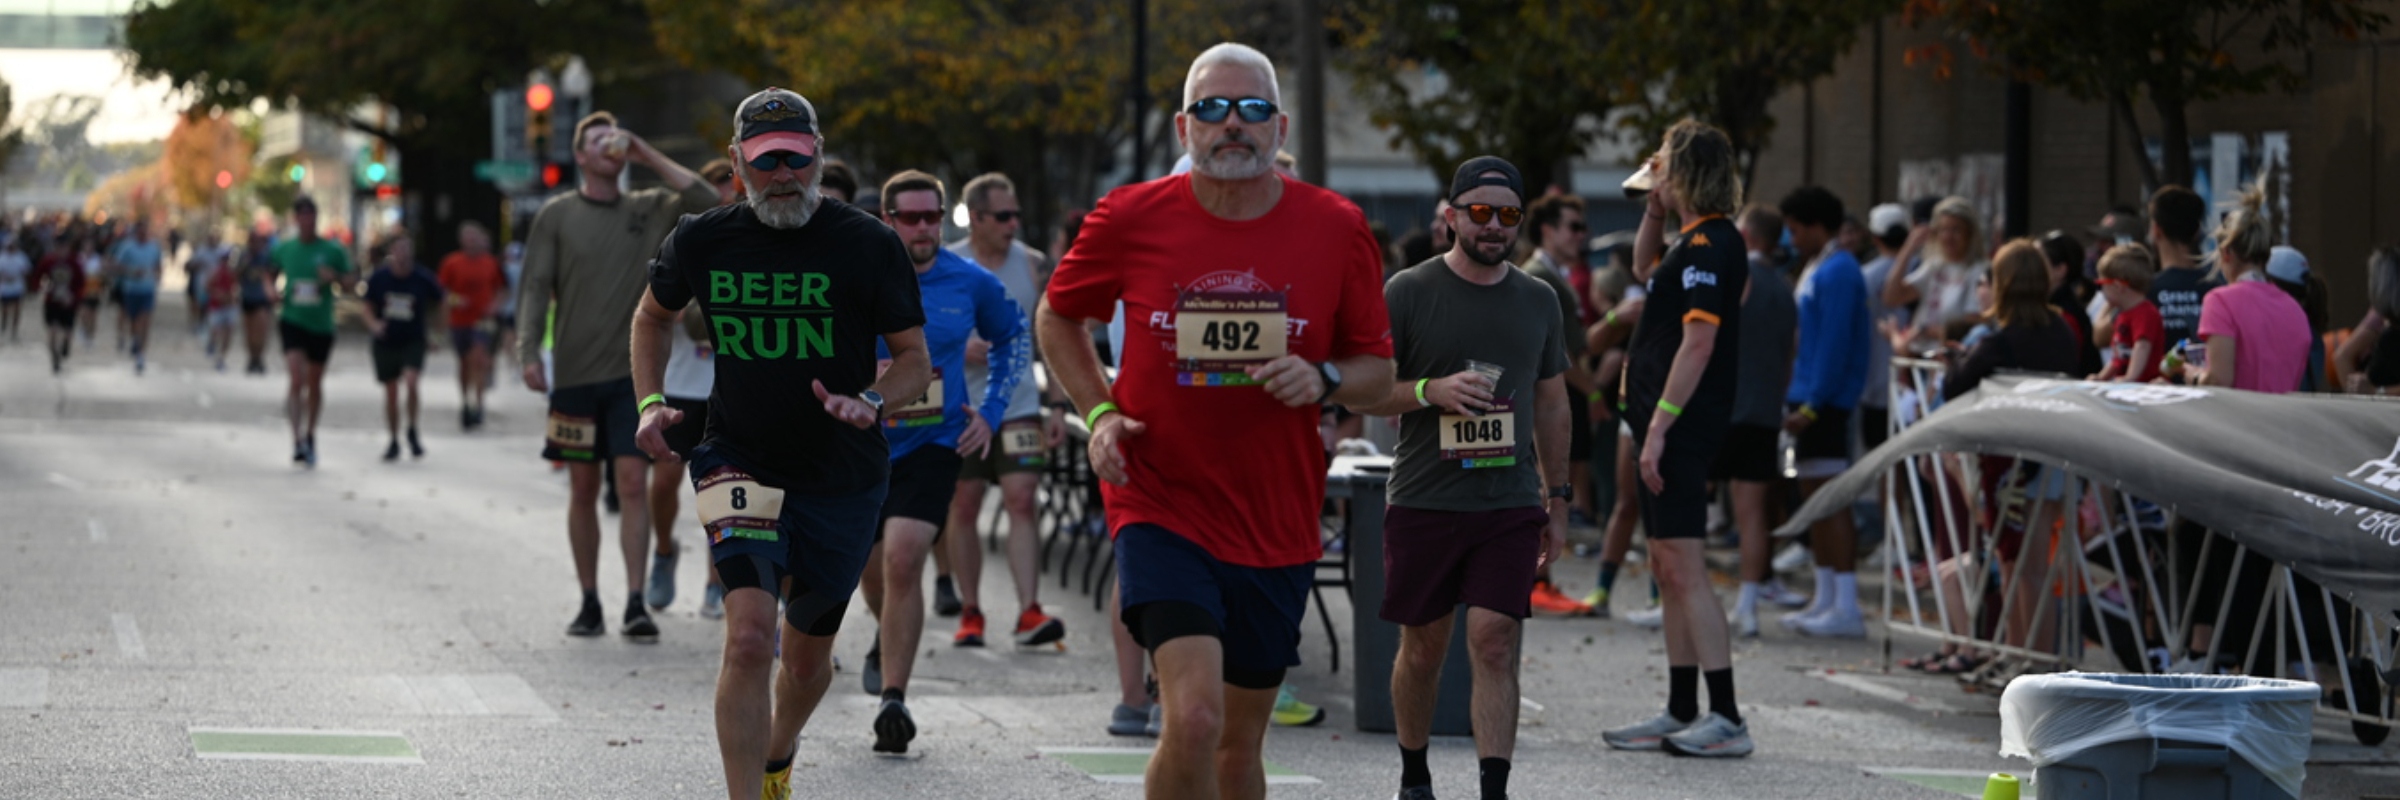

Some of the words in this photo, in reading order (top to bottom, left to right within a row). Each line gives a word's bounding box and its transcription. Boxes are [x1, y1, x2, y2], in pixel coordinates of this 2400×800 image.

[709, 270, 832, 307] BEER
[1193, 274, 1243, 293] AINING
[1237, 300, 1257, 310] Pub
[1258, 300, 1279, 310] Run
[2160, 304, 2202, 317] chang
[710, 315, 835, 360] RUN
[1202, 321, 1260, 352] 492
[1453, 419, 1502, 443] 1048
[731, 486, 747, 511] 8
